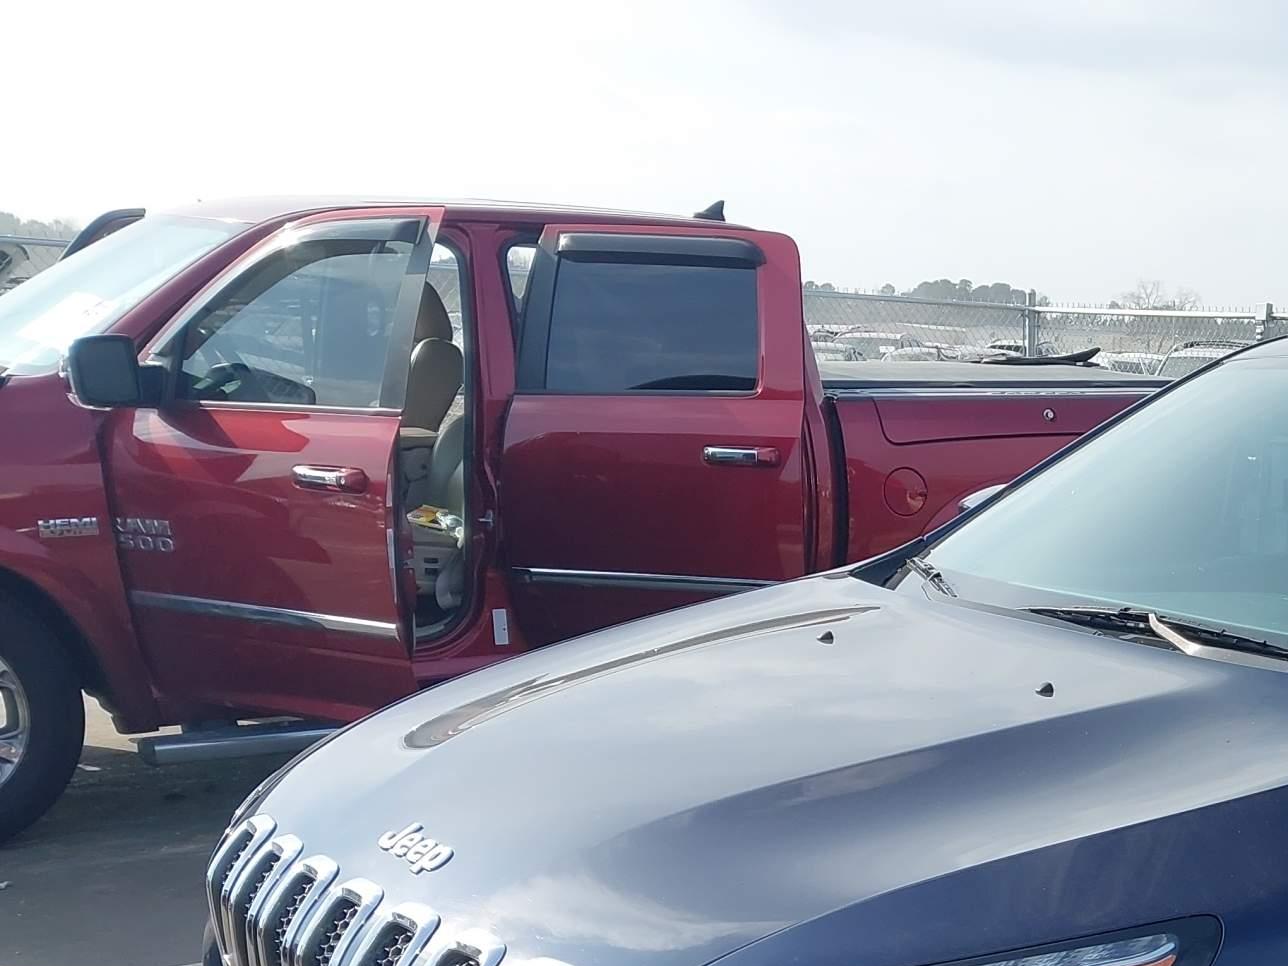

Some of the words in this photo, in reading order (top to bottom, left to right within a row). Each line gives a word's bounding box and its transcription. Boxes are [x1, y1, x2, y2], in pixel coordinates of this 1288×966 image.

[37, 516, 97, 530] HEMI
[119, 534, 174, 552] 500
[377, 822, 455, 876] Jeep
